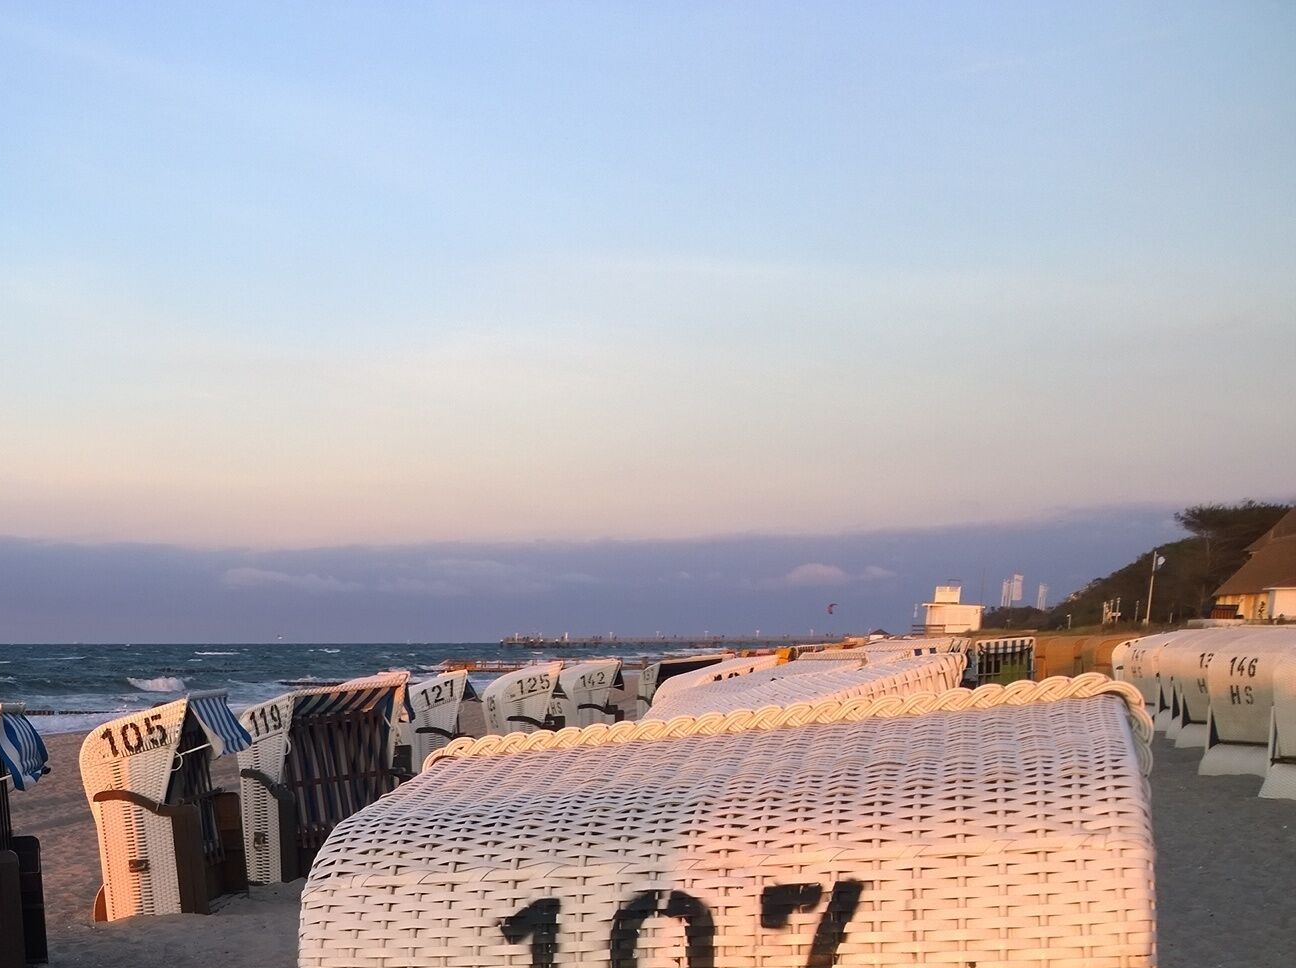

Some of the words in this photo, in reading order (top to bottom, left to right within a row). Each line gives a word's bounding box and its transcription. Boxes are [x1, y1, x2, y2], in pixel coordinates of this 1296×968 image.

[1230, 656, 1258, 678] 146
[517, 674, 550, 695] 125
[580, 671, 606, 687] 142
[1197, 678, 1208, 694] H
[421, 679, 454, 706] 127
[1230, 684, 1254, 705] HS
[249, 704, 282, 737] 119
[100, 713, 168, 758] 105
